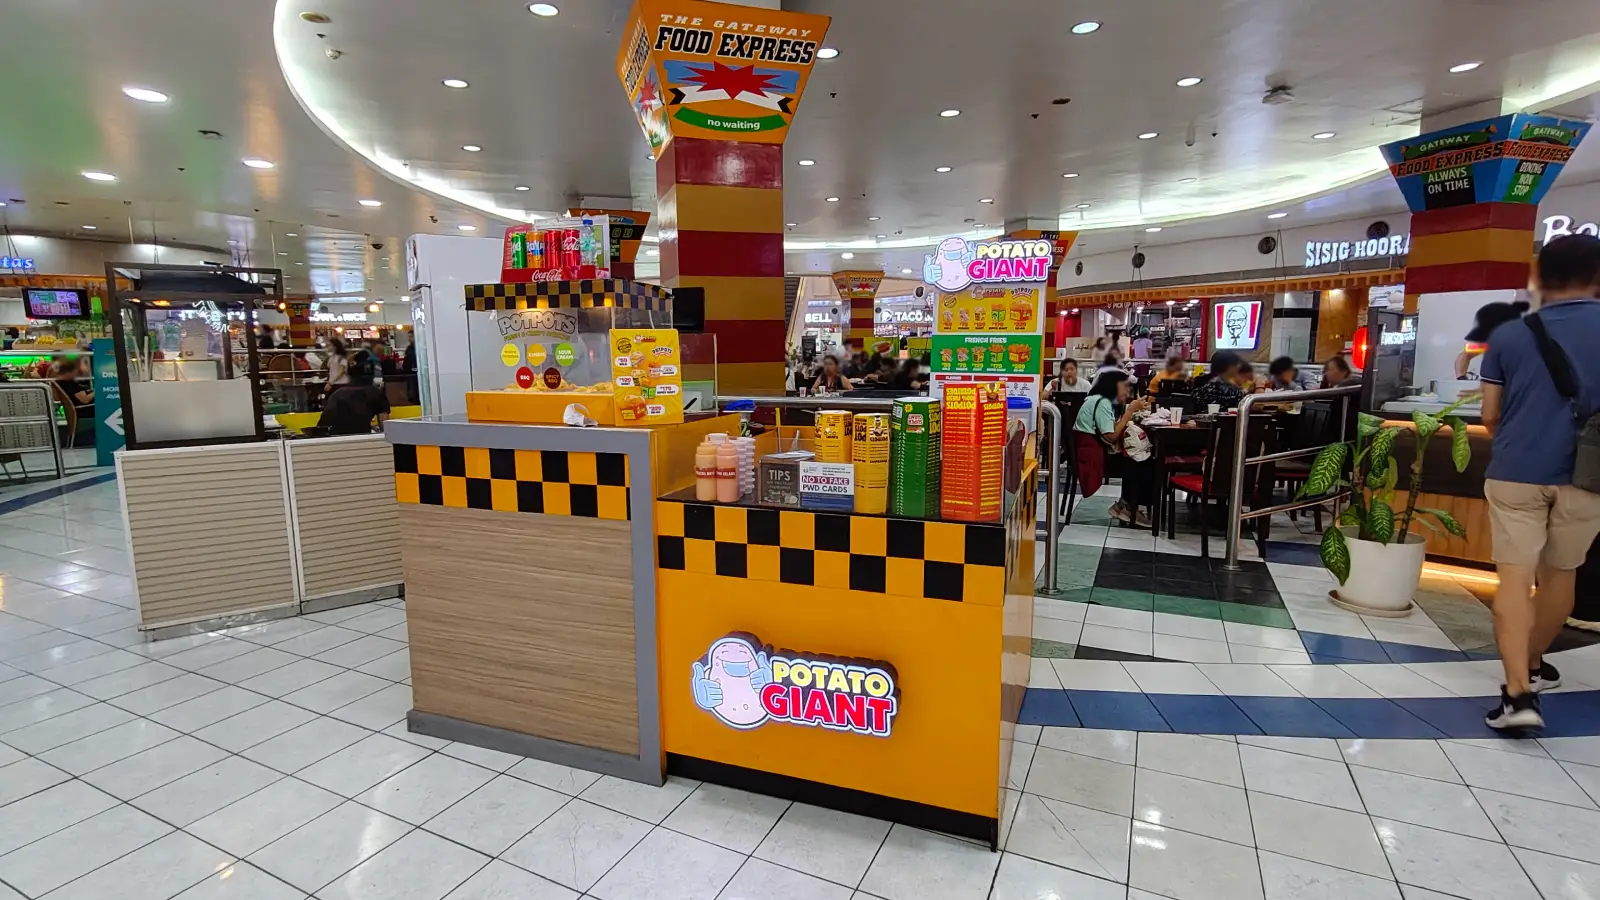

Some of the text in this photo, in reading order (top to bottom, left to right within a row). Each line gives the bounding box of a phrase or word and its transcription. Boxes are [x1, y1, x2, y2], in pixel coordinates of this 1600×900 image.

[660, 14, 811, 37] THE GATEWAY
[654, 25, 818, 65] FOOD EXPRESS
[707, 118, 761, 131] no waiting
[1533, 127, 1565, 138] GATEWAY
[1419, 134, 1471, 152] GATEWAY
[1398, 142, 1505, 177] FOOD EXPRESS
[1506, 143, 1576, 162] FOOD EXPRESS
[1428, 166, 1467, 184] ALWAYS
[1519, 162, 1544, 174] DINING
[1428, 178, 1470, 195] ON TIME
[1519, 175, 1534, 185] NON
[1512, 185, 1530, 196] STOP
[977, 242, 1049, 259] POTATO
[1305, 241, 1351, 268] SISIG
[968, 257, 1049, 279] GIANT
[497, 311, 577, 336] POTPOTS
[804, 312, 832, 323] BELL
[895, 311, 922, 321] TACO
[946, 401, 977, 410] POTPOTS
[854, 425, 867, 433] POTS
[854, 432, 867, 442] POT
[768, 469, 791, 480] TIPS
[802, 484, 820, 492] PWD
[822, 485, 848, 493] CARDS
[772, 661, 890, 697] POTATO
[761, 683, 892, 731] GIANT
